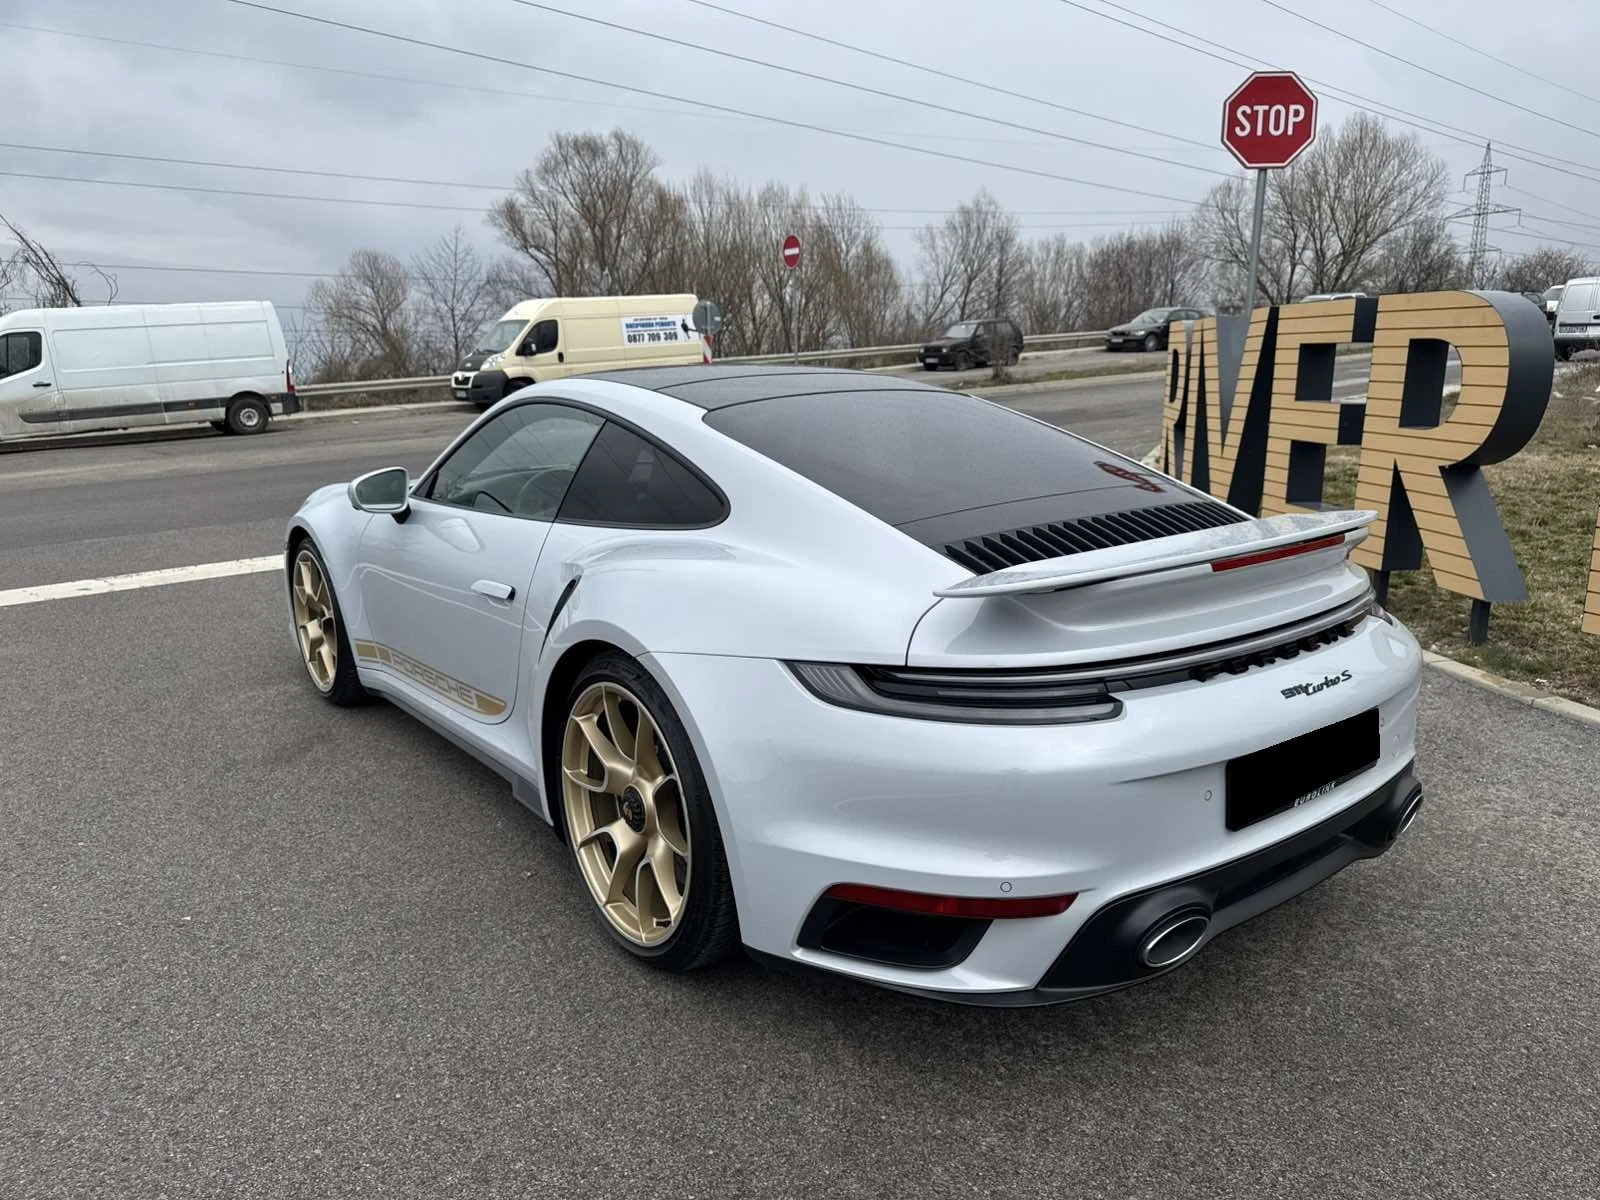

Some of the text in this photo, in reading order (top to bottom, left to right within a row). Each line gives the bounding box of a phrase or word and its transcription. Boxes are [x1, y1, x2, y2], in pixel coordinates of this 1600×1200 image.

[1234, 104, 1305, 137] STOP
[1162, 290, 1550, 602] RIVER
[1341, 669, 1353, 682] S
